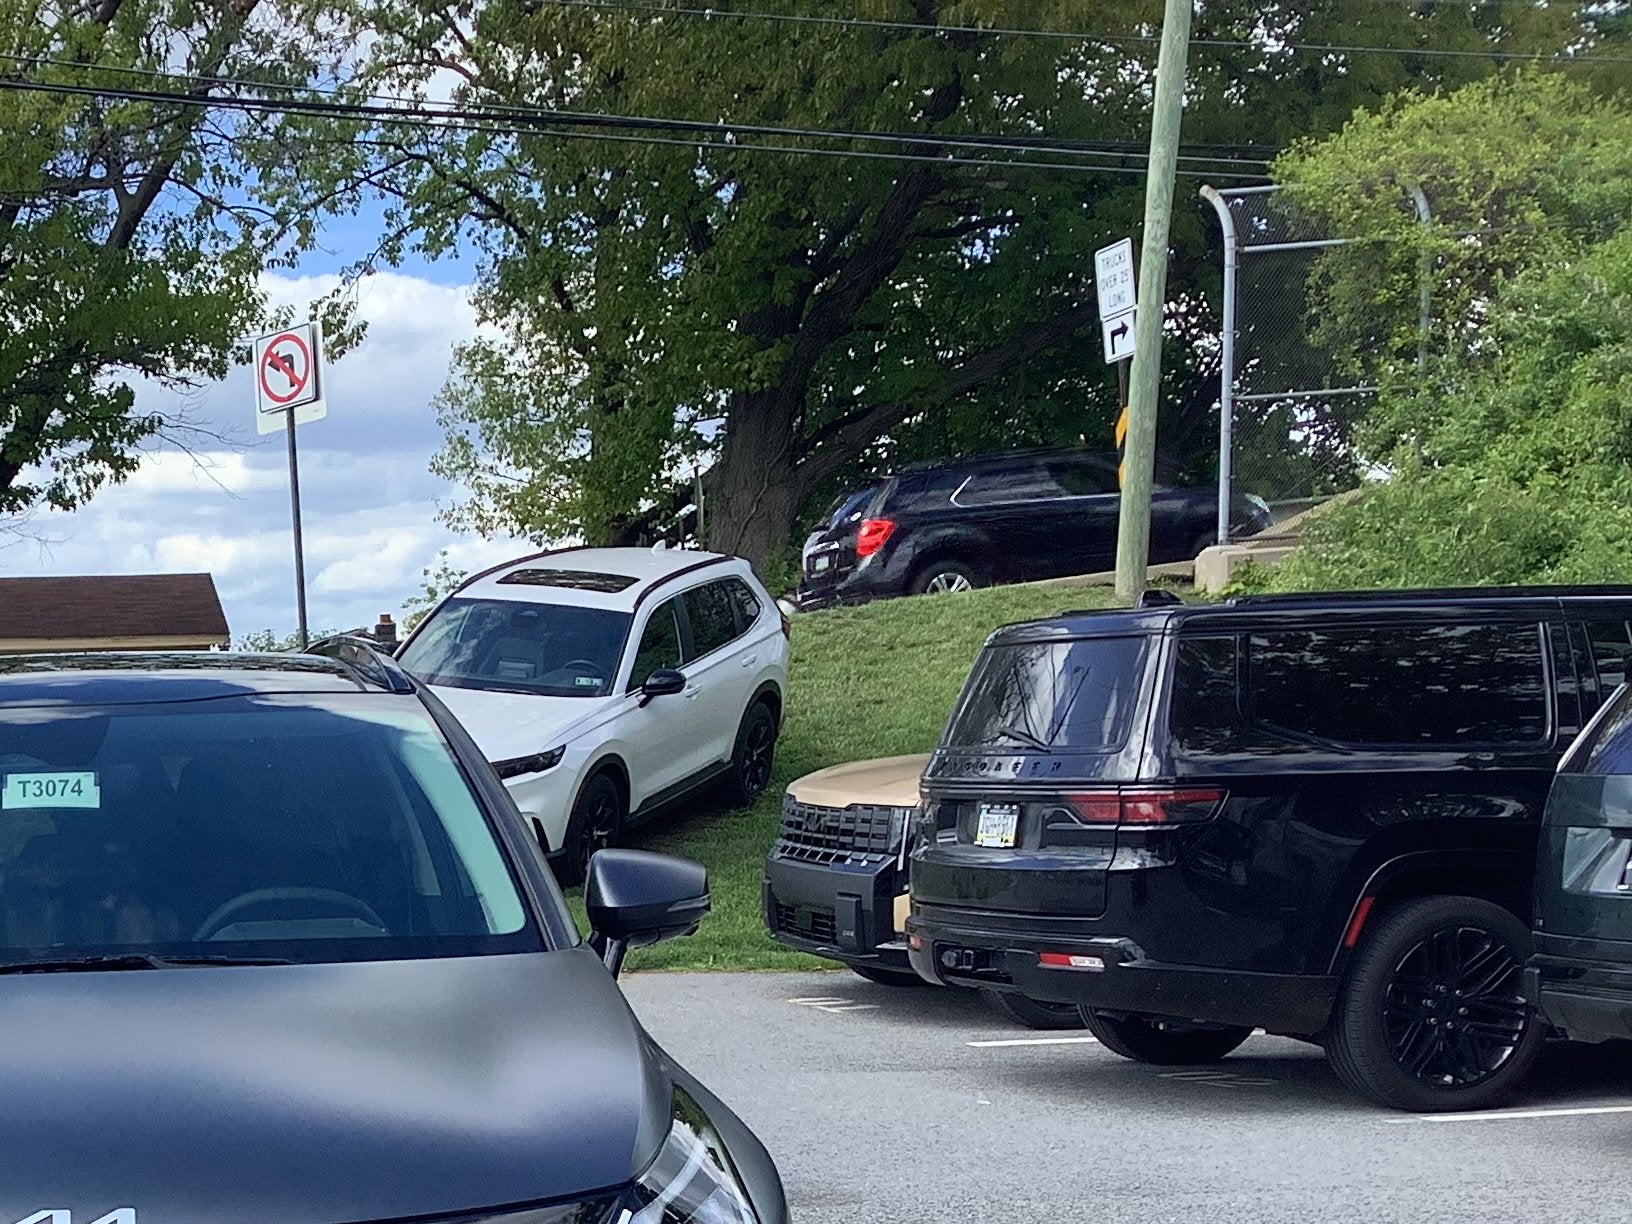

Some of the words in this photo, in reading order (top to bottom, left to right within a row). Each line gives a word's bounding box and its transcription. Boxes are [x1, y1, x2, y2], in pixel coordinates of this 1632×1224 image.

[1102, 250, 1126, 270] TRUCKS
[1101, 273, 1117, 291] OVER
[1108, 290, 1126, 308] LONG
[17, 779, 83, 798] T3074
